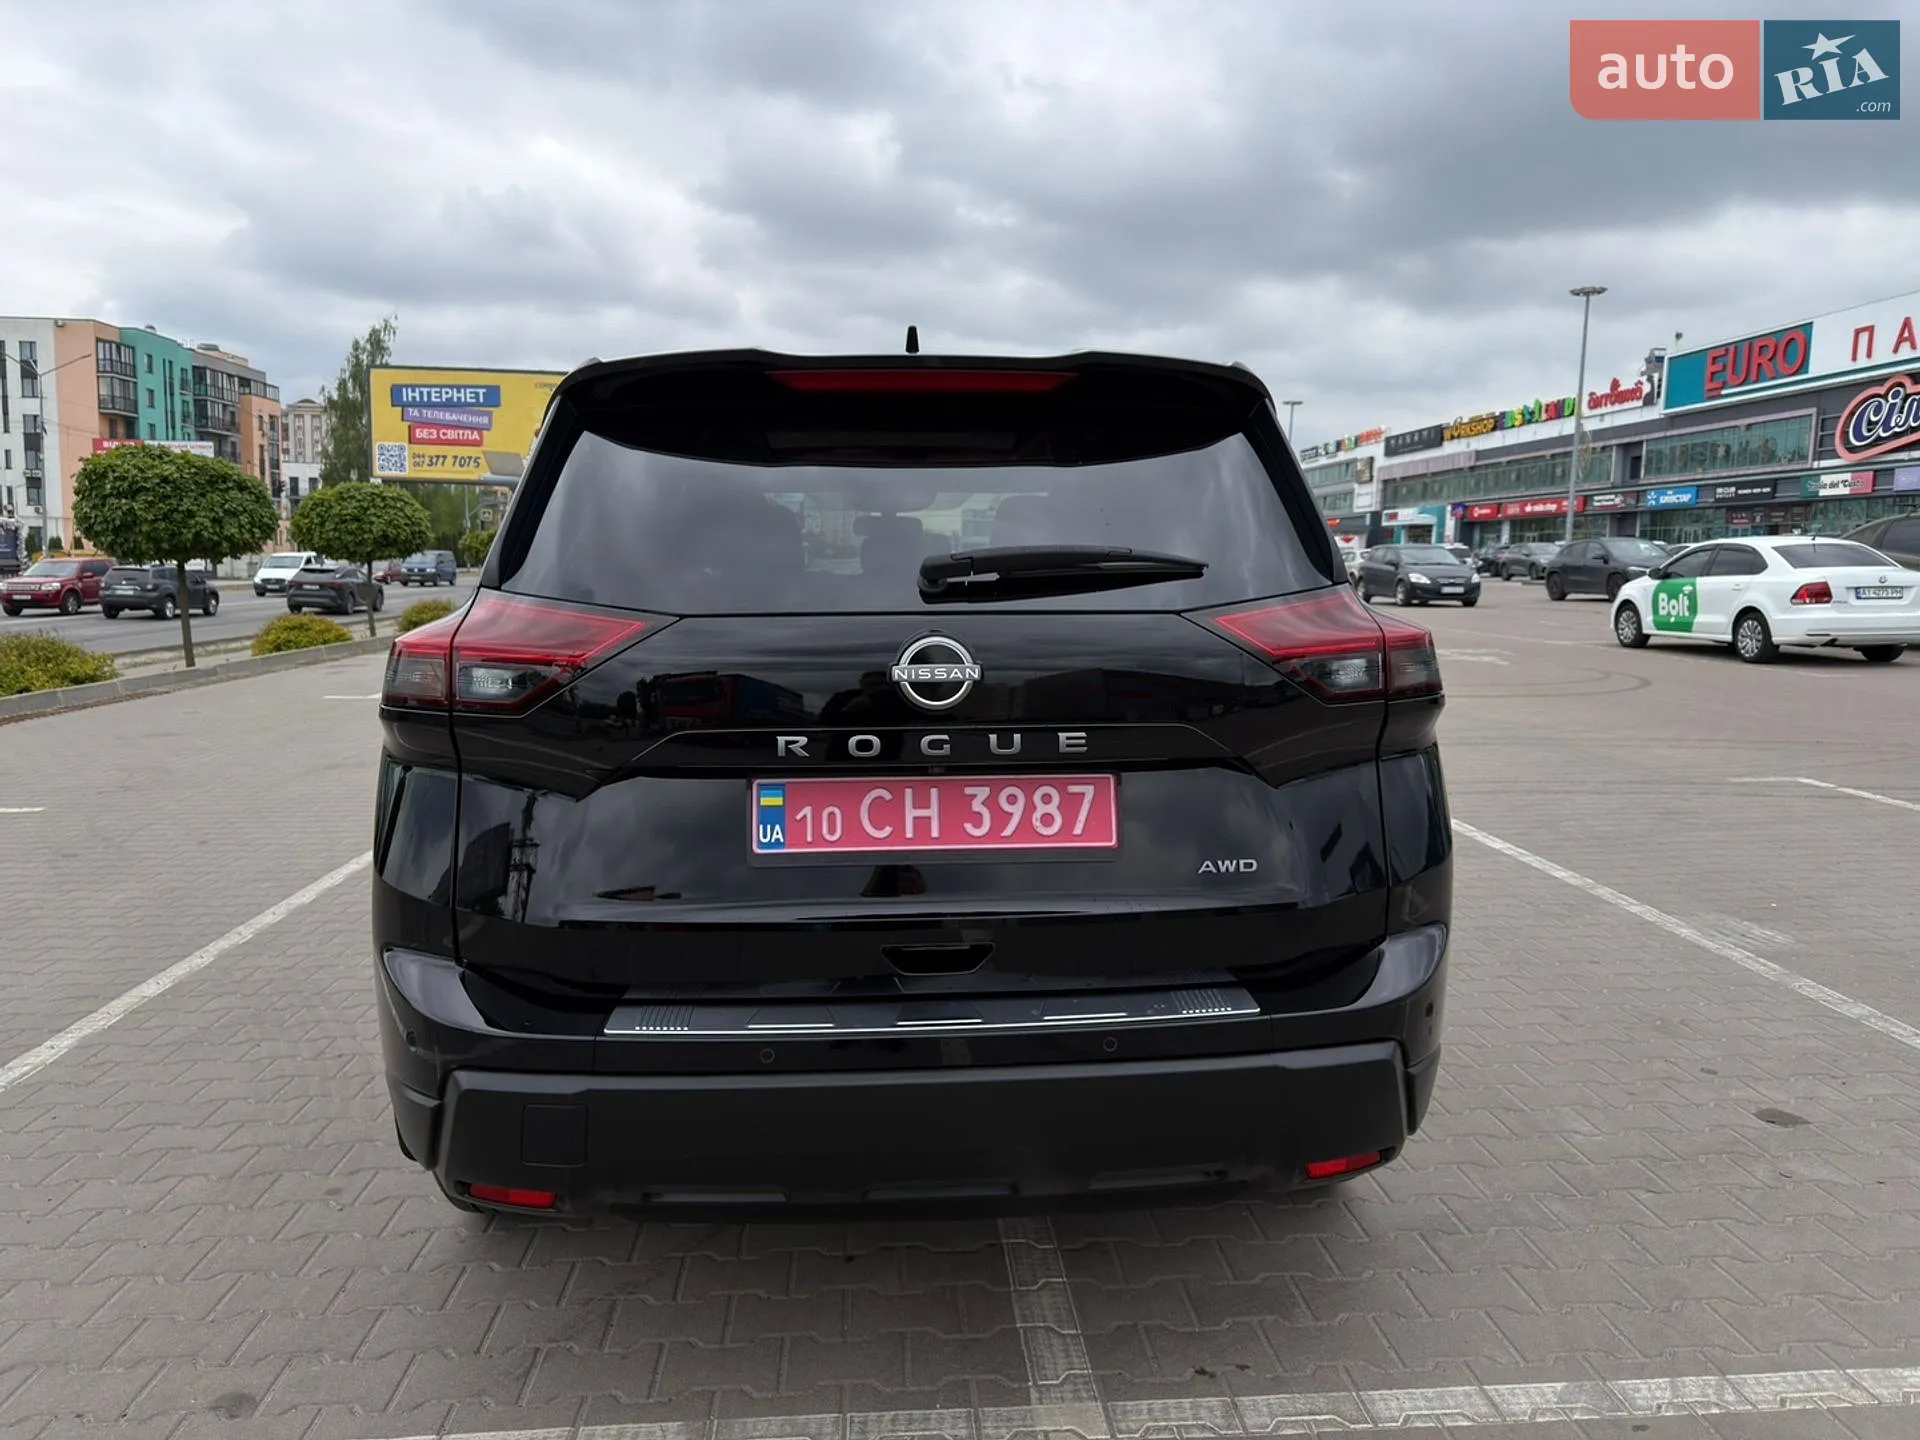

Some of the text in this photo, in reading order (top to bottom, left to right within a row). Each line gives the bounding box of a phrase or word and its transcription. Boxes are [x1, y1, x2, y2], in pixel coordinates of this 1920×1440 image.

[1704, 328, 1808, 392] EURO
[402, 386, 487, 403] ІНТЕРНЕТ
[408, 407, 489, 425] ТА ТЕЛЕБАЧЕННЯ
[415, 427, 481, 441] БЕЗ СВІТЛА
[427, 454, 481, 469] 377 7075
[1657, 590, 1690, 619] Bolt
[893, 665, 981, 681] NISSAN
[775, 731, 1089, 758] ROGUE
[794, 783, 1098, 844] 10 CH 3987
[758, 823, 784, 844] UA
[1197, 858, 1259, 874] AWD
